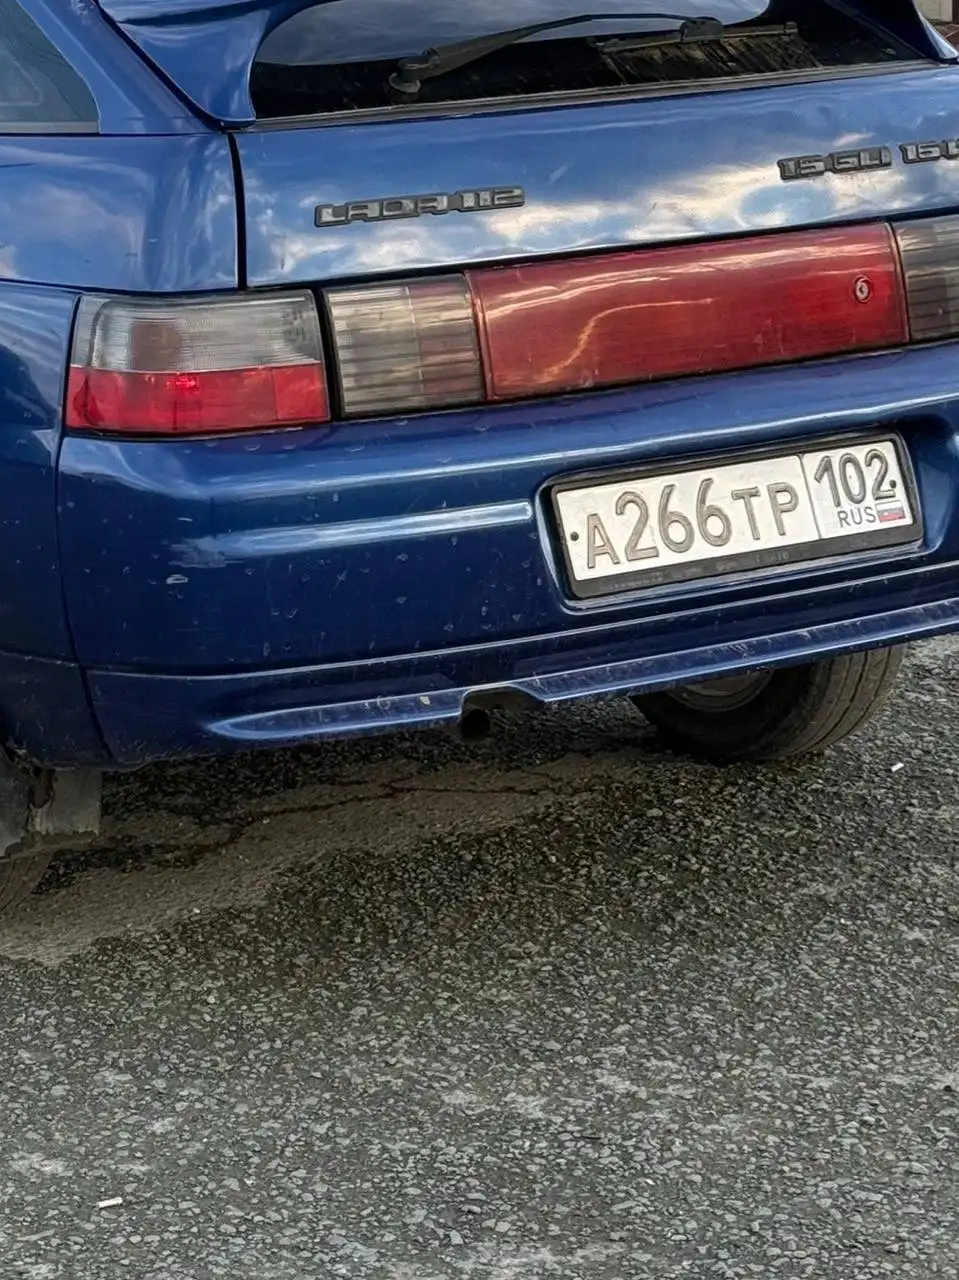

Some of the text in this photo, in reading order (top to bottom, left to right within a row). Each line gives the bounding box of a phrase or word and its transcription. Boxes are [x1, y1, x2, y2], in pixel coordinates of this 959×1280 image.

[318, 188, 525, 224] LADA 112
[585, 447, 897, 570] А266ТР 102
[838, 505, 877, 529] RUS
